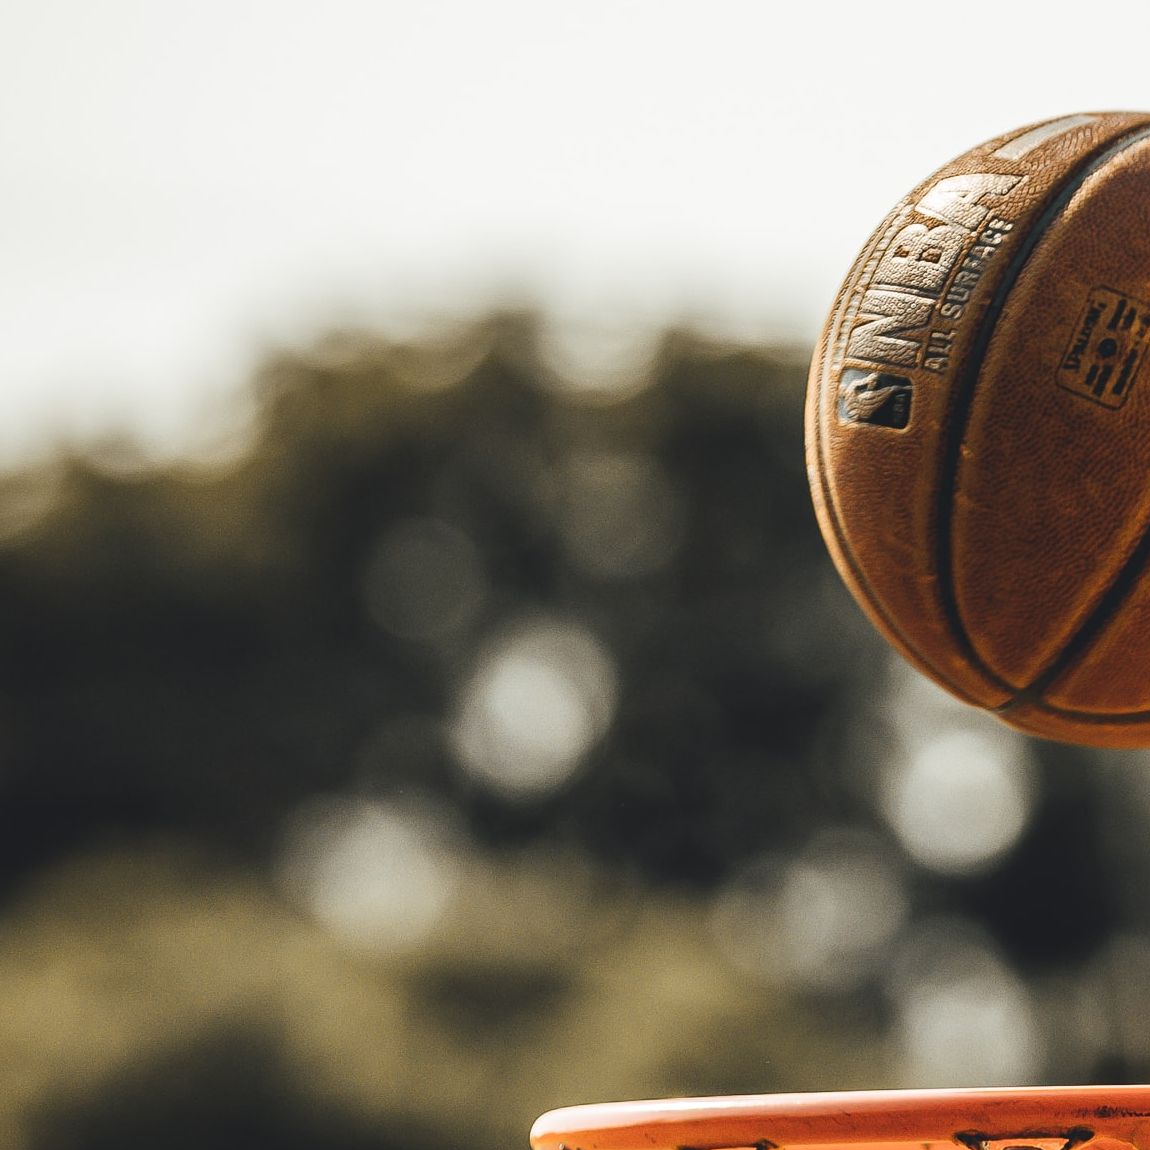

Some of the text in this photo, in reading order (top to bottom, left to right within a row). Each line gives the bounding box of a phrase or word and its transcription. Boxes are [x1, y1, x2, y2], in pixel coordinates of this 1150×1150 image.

[846, 173, 1026, 368] NBA
[922, 218, 1014, 374] ALL SURFACE
